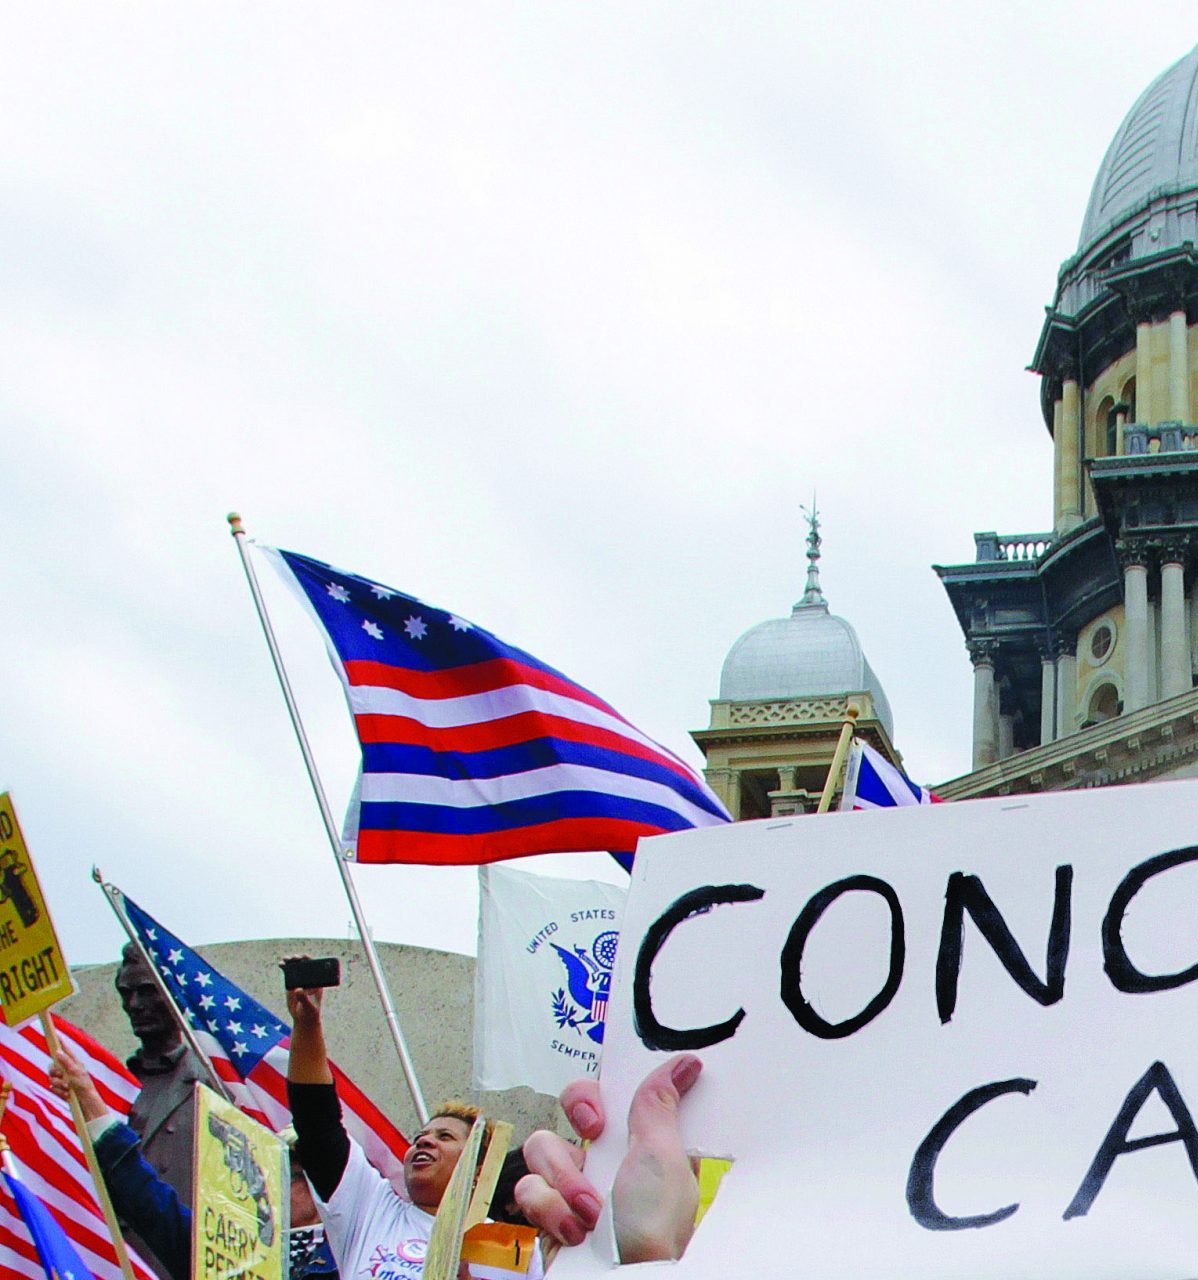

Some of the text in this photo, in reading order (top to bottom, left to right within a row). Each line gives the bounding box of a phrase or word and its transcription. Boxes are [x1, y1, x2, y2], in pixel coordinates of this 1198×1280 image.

[0, 919, 18, 950] HE
[526, 909, 616, 954] UNITED STATES
[0, 946, 60, 1006] RIGHT
[551, 1039, 596, 1061] SEMPER
[369, 1244, 424, 1273] Secon
